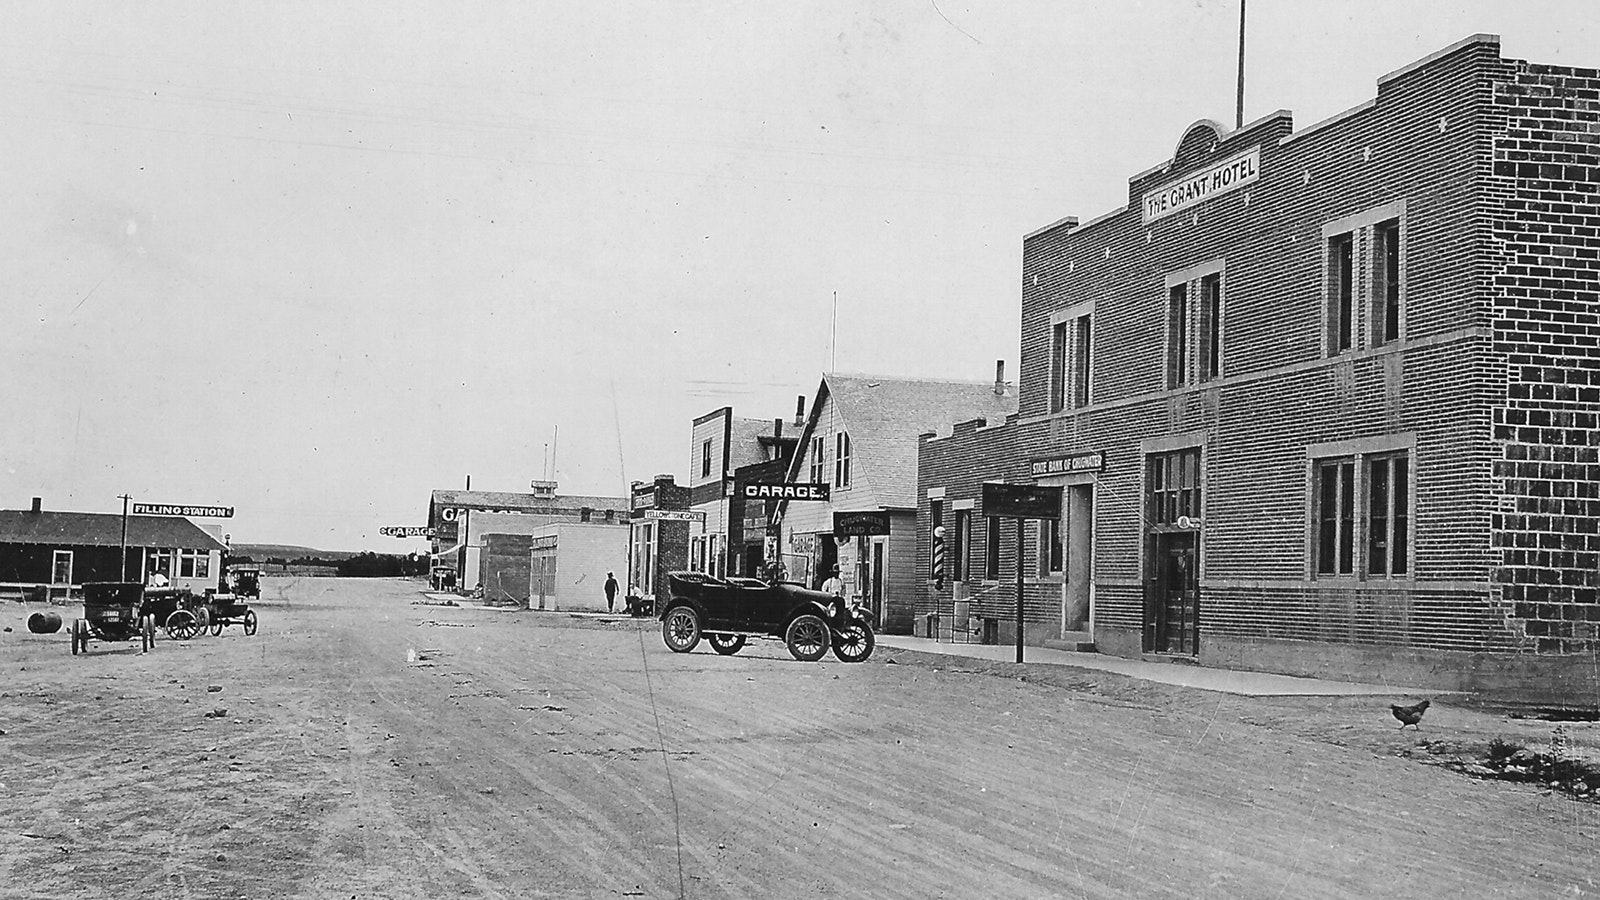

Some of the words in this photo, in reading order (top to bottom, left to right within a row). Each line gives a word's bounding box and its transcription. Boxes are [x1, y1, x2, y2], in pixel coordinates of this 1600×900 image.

[1148, 194, 1167, 217] THE
[1170, 176, 1208, 207] GRANT
[1212, 158, 1256, 190] HOTEL
[1032, 461, 1047, 474] STATE
[1048, 460, 1063, 472] BANK
[1063, 458, 1071, 470] OF
[134, 504, 182, 515] FILLING
[182, 506, 226, 517] STATION
[646, 510, 685, 519] YELLOWONE
[387, 527, 436, 537] GARAGE
[843, 526, 865, 534] LAND
